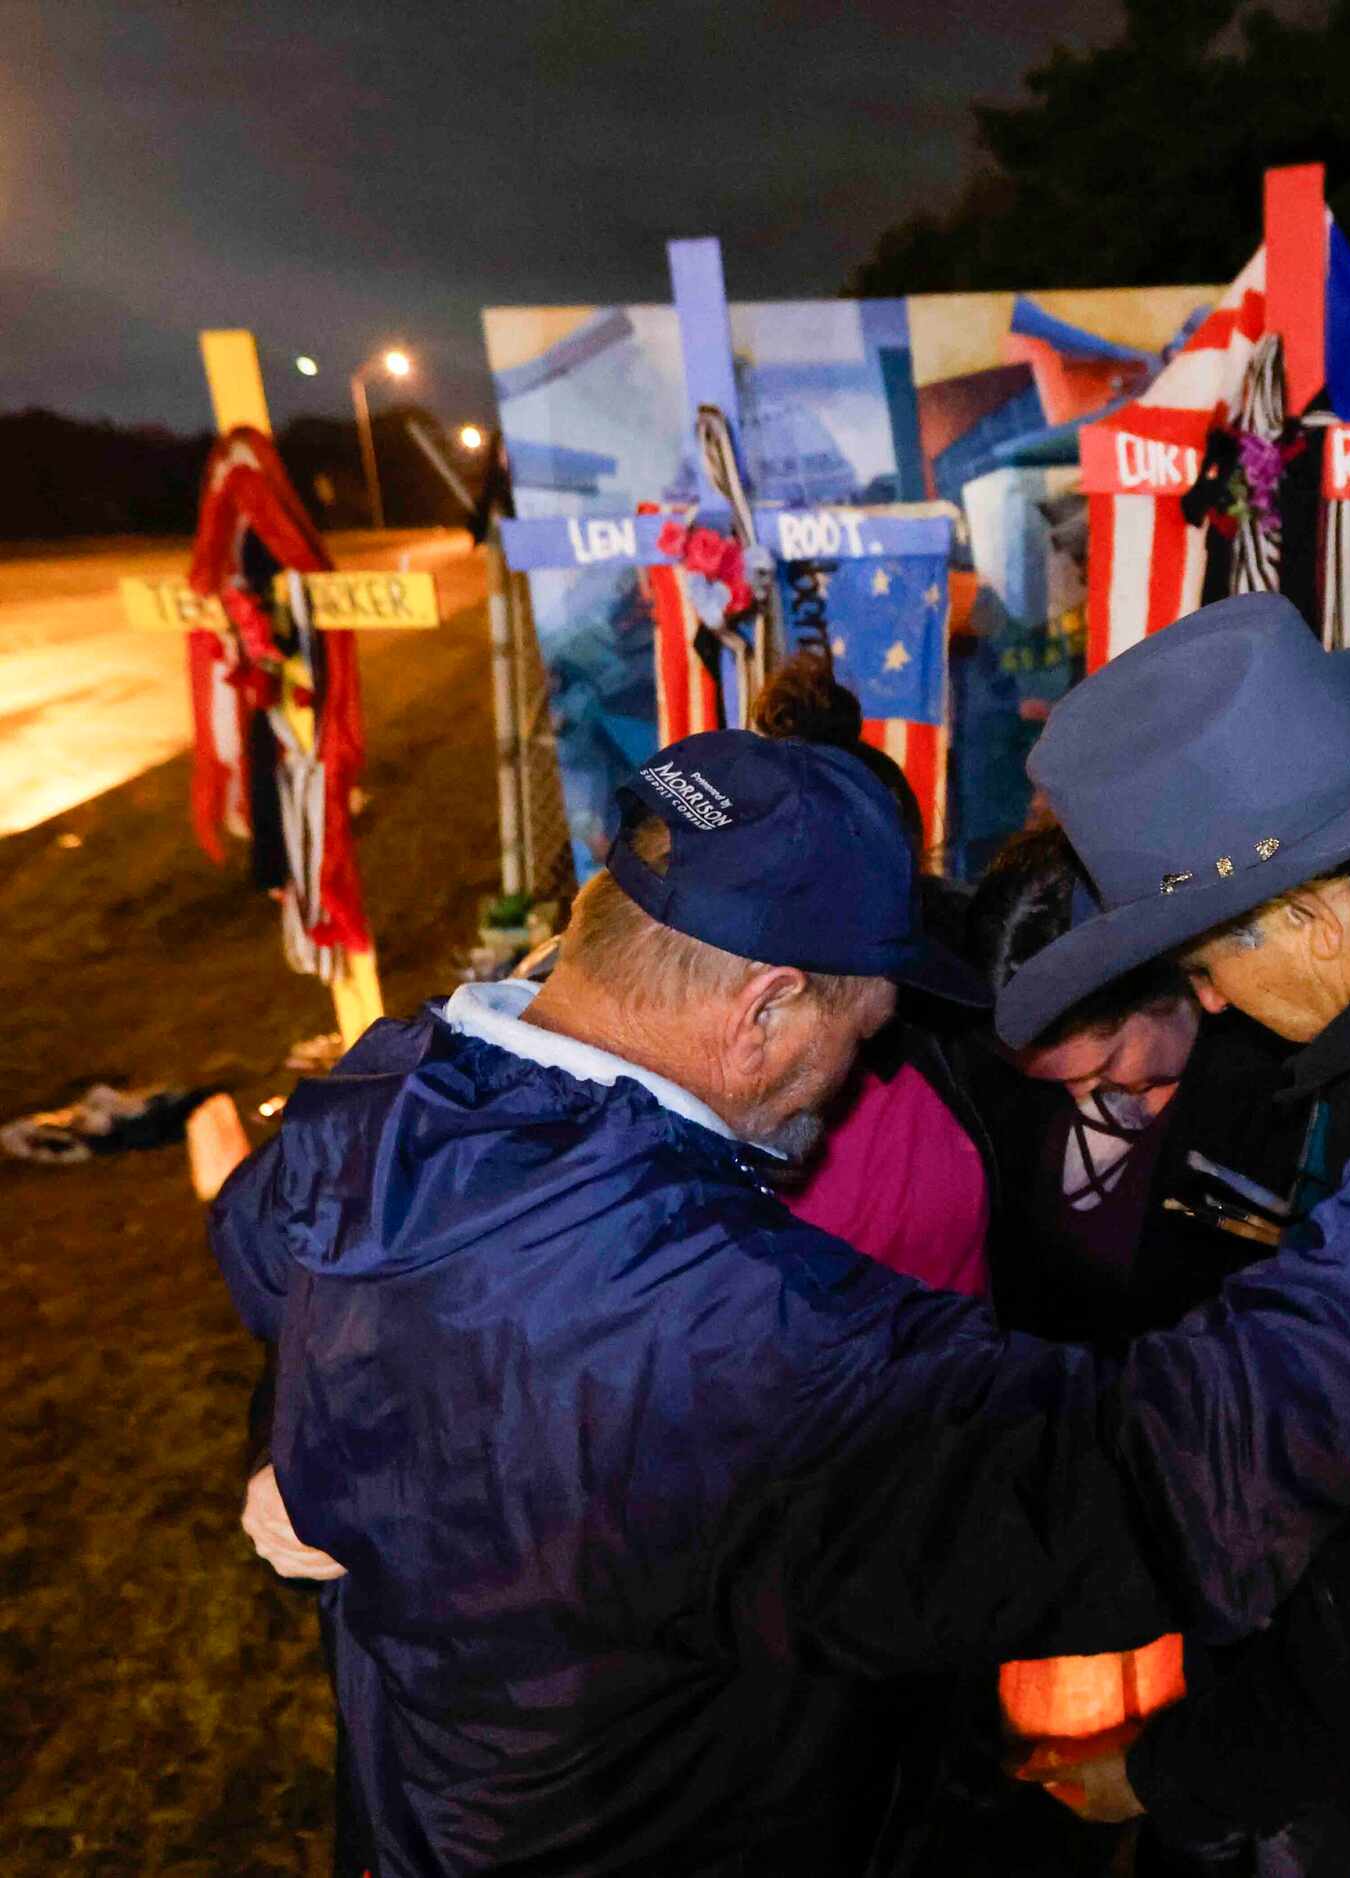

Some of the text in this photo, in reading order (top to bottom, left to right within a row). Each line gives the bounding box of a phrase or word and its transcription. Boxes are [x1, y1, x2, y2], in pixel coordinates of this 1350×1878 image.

[567, 516, 637, 564] LEN
[640, 769, 713, 830] SUPPLY COMPANY
[653, 760, 734, 827] MORRISON
